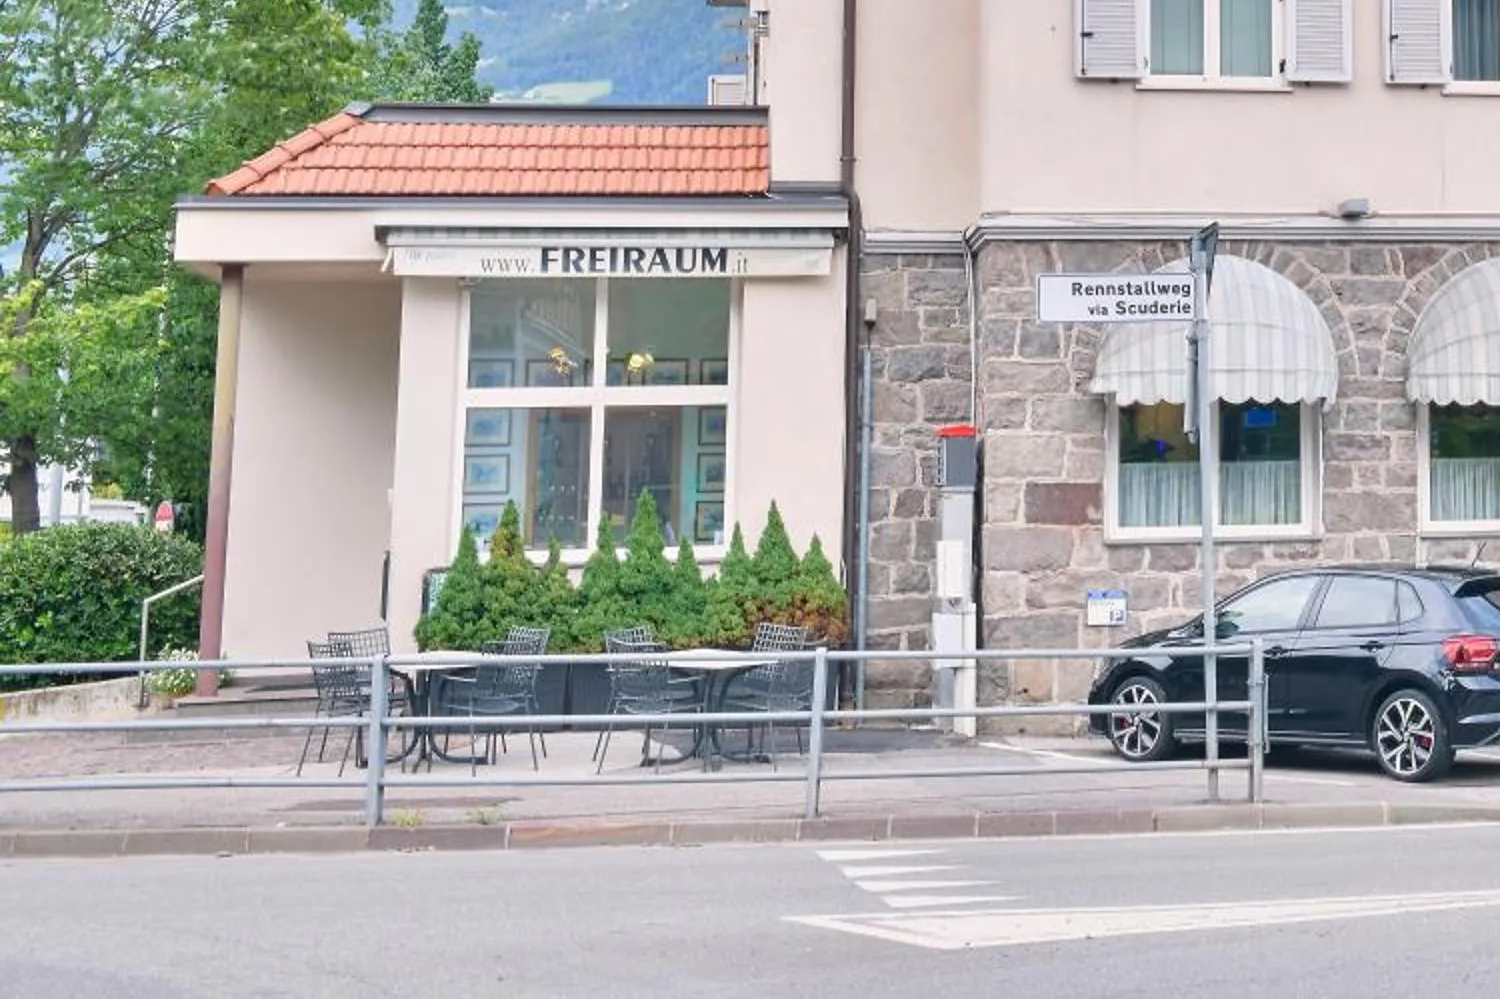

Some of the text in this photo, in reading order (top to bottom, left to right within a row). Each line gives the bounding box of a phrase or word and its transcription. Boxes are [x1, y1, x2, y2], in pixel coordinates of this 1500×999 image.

[1072, 282, 1191, 297] Rennstallweg
[1088, 300, 1191, 316] via Scuderie
